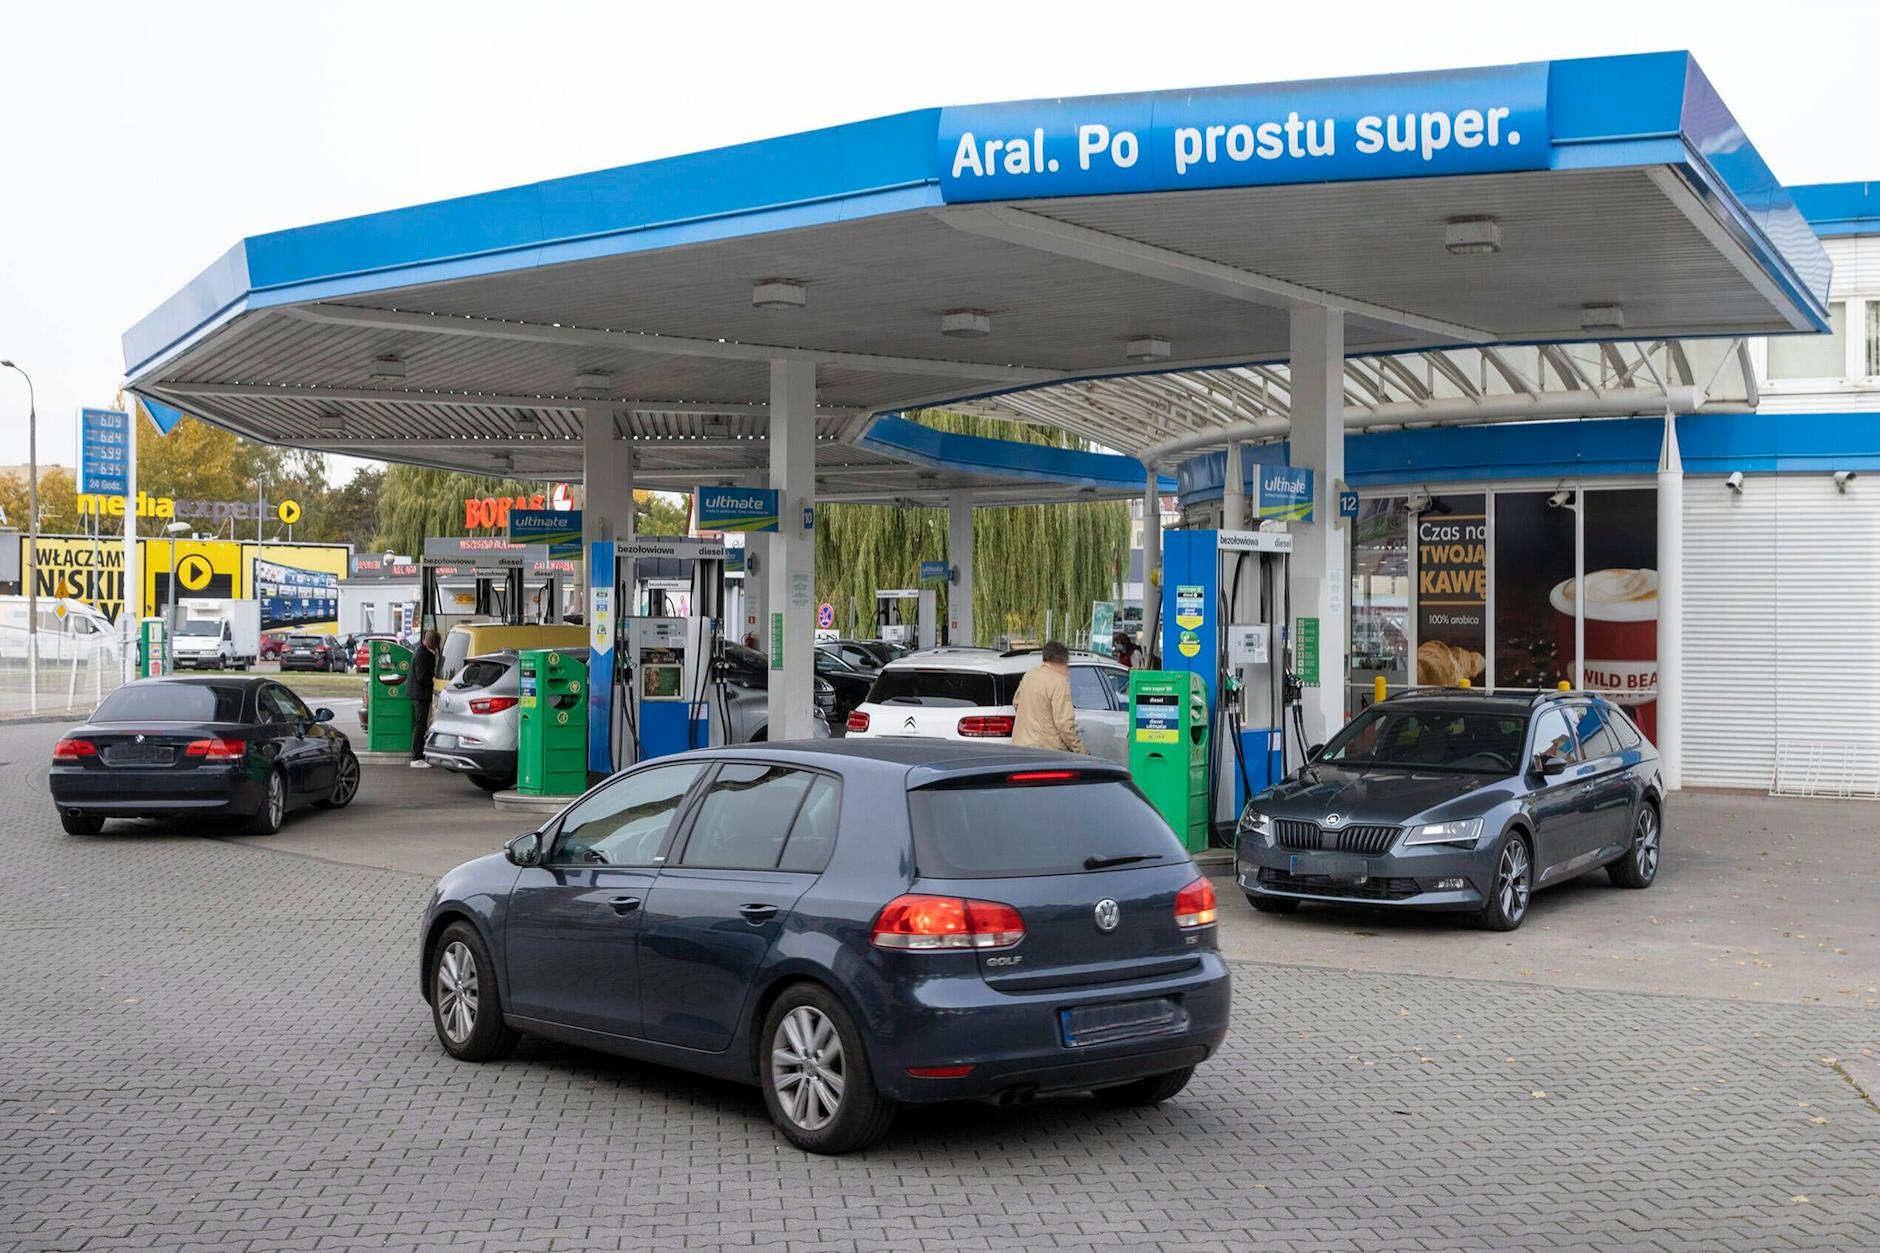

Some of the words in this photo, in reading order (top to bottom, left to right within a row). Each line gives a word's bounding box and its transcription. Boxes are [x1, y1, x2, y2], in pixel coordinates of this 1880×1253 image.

[951, 128, 1060, 178] Aral.
[1078, 123, 1139, 170] Po
[1174, 110, 1335, 175] prostu
[1354, 104, 1521, 162] super.
[88, 479, 100, 489] 24
[1264, 476, 1306, 494] ultimate
[705, 495, 764, 510] ultimate
[1341, 496, 1357, 511] 12
[515, 516, 568, 528] ultimate
[804, 512, 813, 524] 10
[1420, 522, 1460, 541] Czas
[698, 547, 724, 555] diesel
[1420, 570, 1487, 600] KAWĘ
[1429, 615, 1449, 625] 100%
[1451, 614, 1479, 625] arabica
[986, 955, 1022, 967] GOLF
